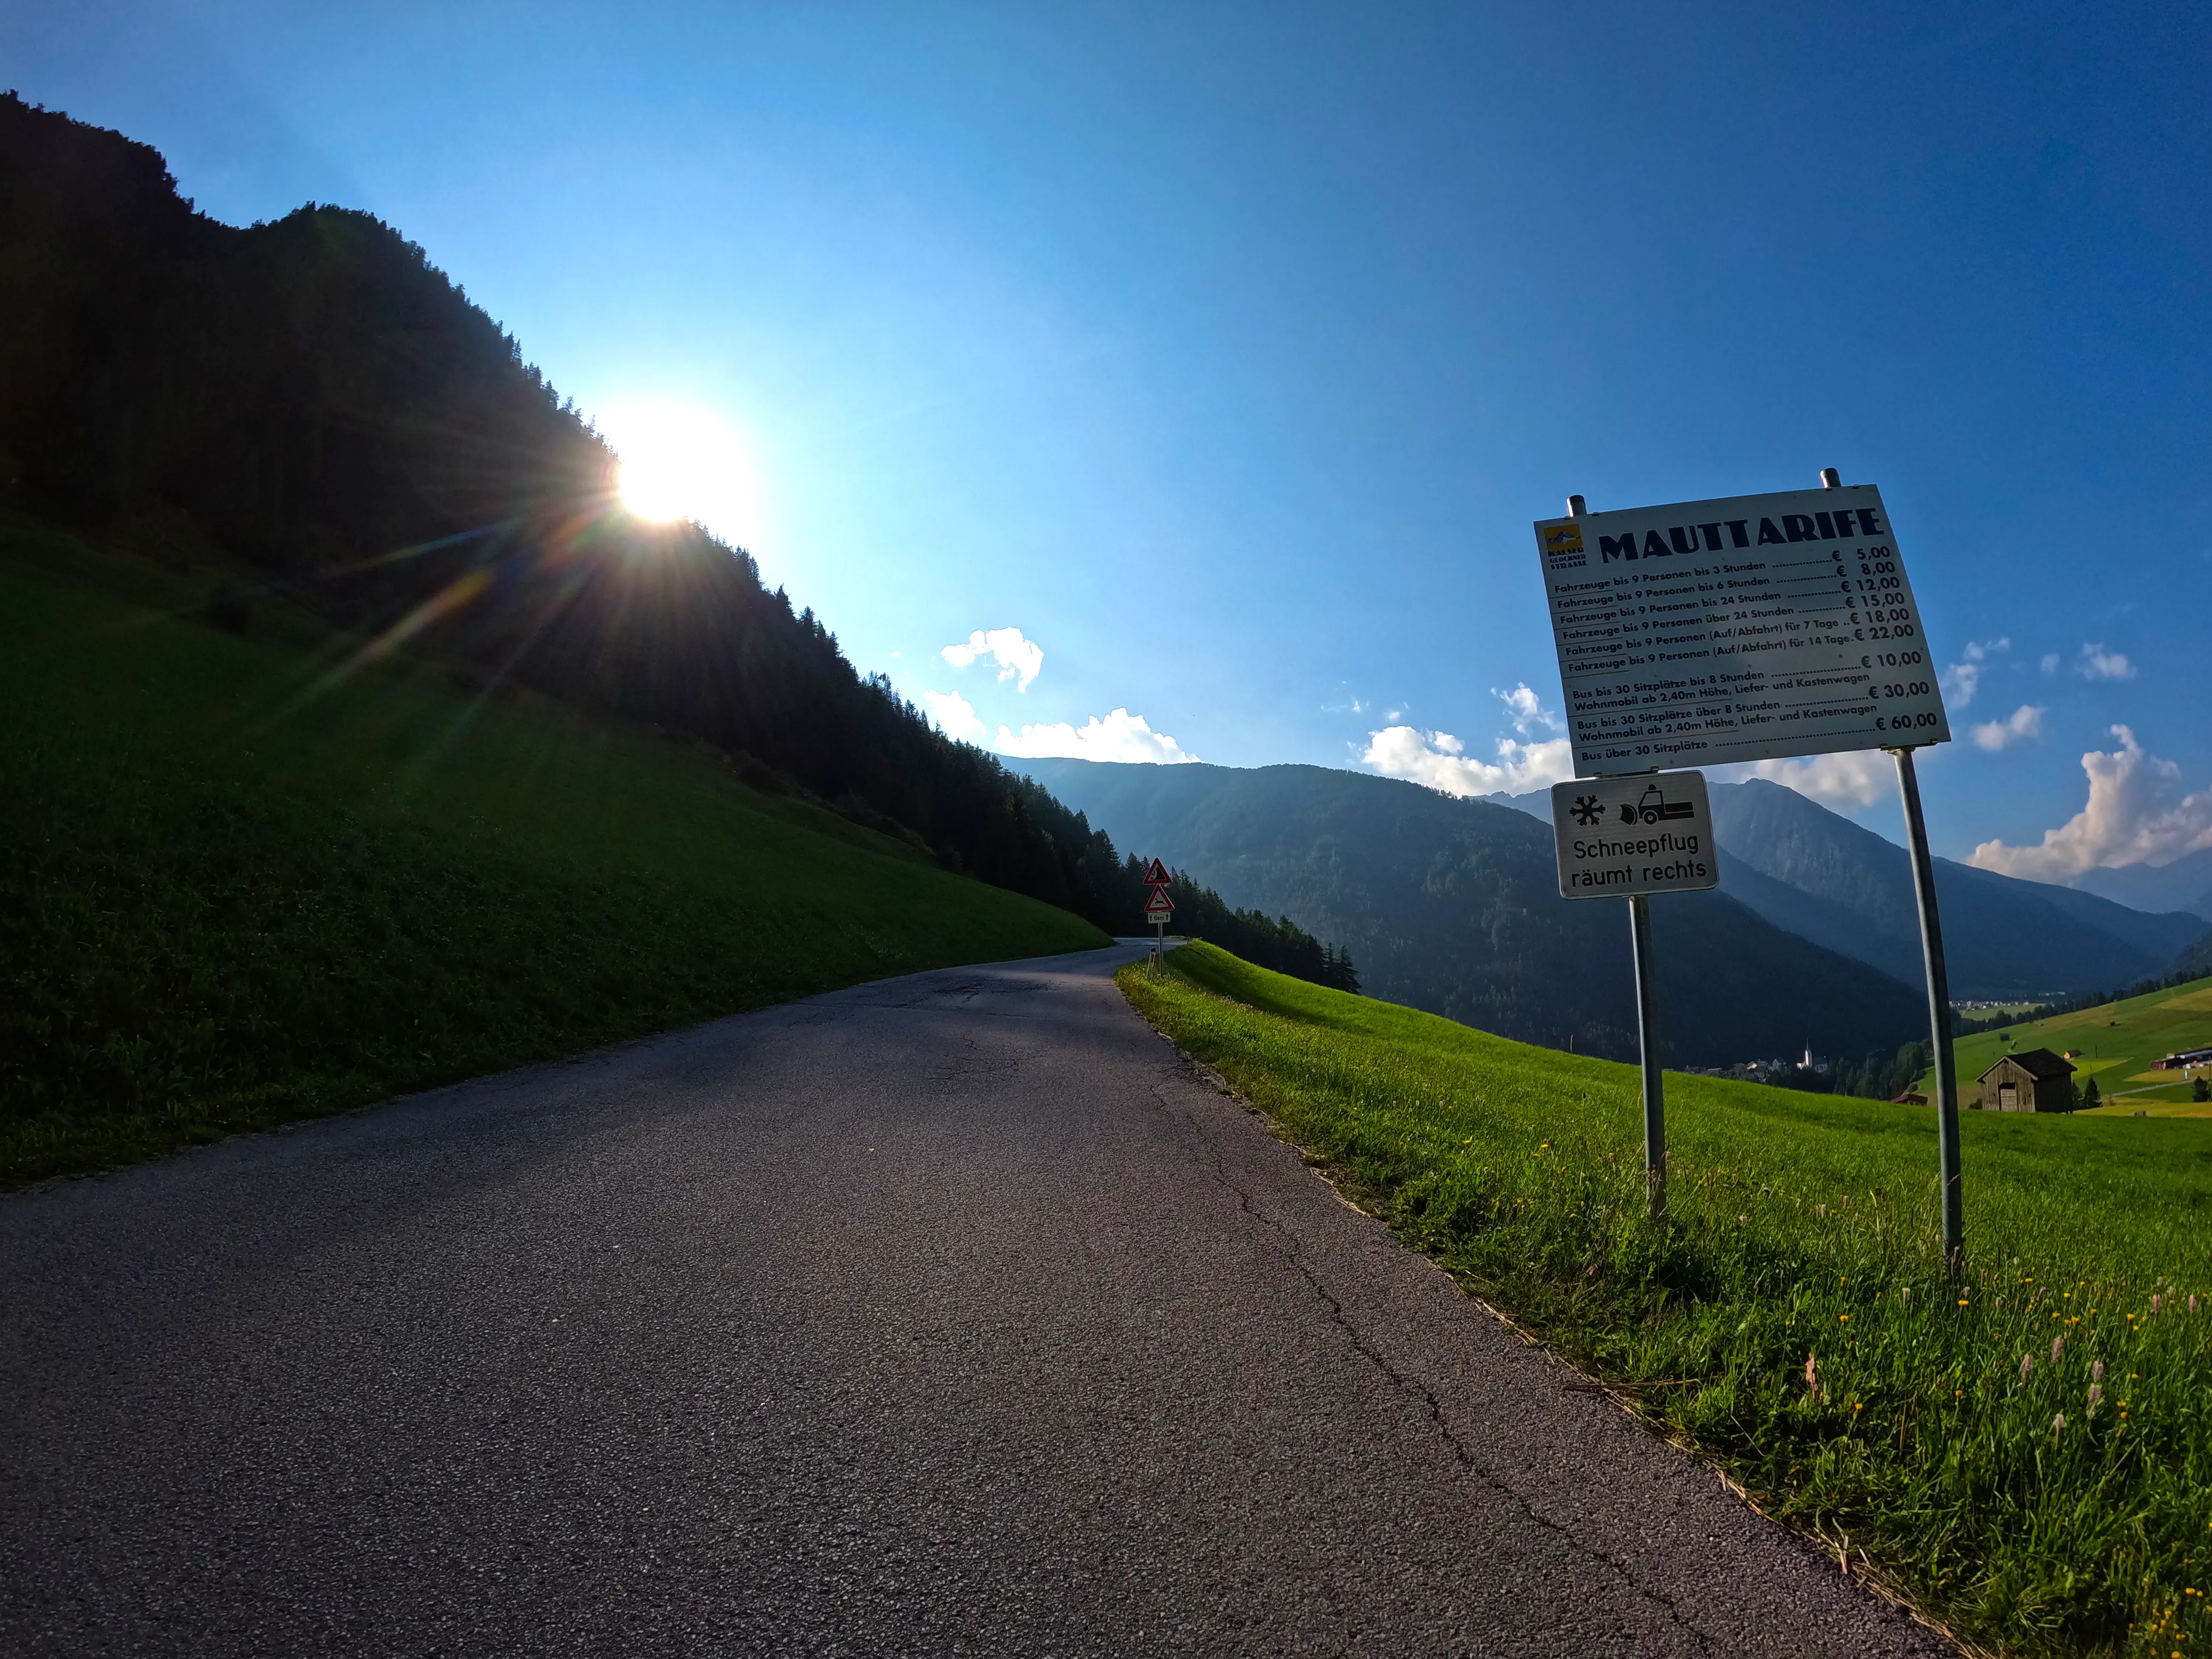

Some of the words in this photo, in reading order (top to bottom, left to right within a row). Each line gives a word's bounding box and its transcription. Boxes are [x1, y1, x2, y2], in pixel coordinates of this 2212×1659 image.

[1547, 546, 1584, 557] KALSER
[1549, 554, 1586, 563] GLOCKNER
[1598, 507, 1885, 564] MAUTTARIFE
[1550, 559, 1587, 570] STRASSE
[1554, 581, 1610, 593] Fahrzeuge
[1613, 576, 1629, 586] bis
[1631, 575, 1639, 583] 9
[1642, 571, 1692, 582] Personen
[1694, 567, 1710, 576] bis
[1712, 565, 1720, 574] 3
[1723, 562, 1766, 573] Stunden
[1831, 550, 1843, 562] €
[1857, 545, 1890, 560] 5,00
[1557, 596, 1614, 609] Fahrzeuge
[1616, 591, 1633, 601] bis
[1635, 590, 1642, 598] 9
[1645, 586, 1695, 597] Personen
[1697, 582, 1714, 591] bis
[1717, 581, 1724, 589] 6
[1727, 577, 1770, 588] Stunden
[1836, 565, 1847, 577] €
[1860, 561, 1896, 575] 8,00
[1560, 611, 1617, 624] Fahrzeuge
[1619, 607, 1636, 617] bis
[1638, 605, 1645, 615] 9
[1649, 602, 1699, 613] Personen
[1701, 598, 1717, 607] bis
[1720, 596, 1735, 605] 24
[1737, 591, 1781, 603] Stunden
[1840, 580, 1851, 593] €
[1856, 576, 1900, 591] 12,00
[1562, 627, 1620, 640] Fahrzeuge
[1622, 623, 1639, 632] bis
[1641, 621, 1649, 630] 9
[1652, 618, 1702, 629] Personen
[1705, 613, 1730, 623] über
[1733, 611, 1748, 620] 24
[1751, 606, 1794, 618] Stunden
[1844, 596, 1856, 609] €
[1860, 591, 1905, 607] 15,00
[1566, 643, 1623, 656] Fahrzeuge
[1625, 639, 1642, 649] bis
[1644, 637, 1652, 646] 9
[1655, 633, 1706, 645] Personen
[1709, 623, 1782, 641] (Auf/Abfahrt)
[1785, 622, 1800, 631] für
[1803, 621, 1810, 629] 7
[1812, 619, 1839, 630] Tage
[1849, 612, 1860, 625] €
[1865, 608, 1910, 623] 18,00
[1568, 659, 1626, 672] Fahrzeuge
[1628, 655, 1645, 665] bis
[1648, 653, 1656, 663] 9
[1658, 650, 1710, 662] Personen
[1712, 639, 1786, 658] (Auf/Abfahrt)
[1789, 638, 1805, 648] für
[1808, 636, 1822, 645] 14
[1853, 628, 1865, 641] €
[1869, 624, 1914, 640] 22,00
[1572, 690, 1593, 699] Bus
[1595, 686, 1612, 697] bis
[1615, 684, 1630, 694] 30
[1633, 679, 1687, 692] Sitzplätze
[1689, 676, 1706, 686] bis
[1709, 675, 1717, 684] 8
[1719, 670, 1764, 683] Stunden
[1860, 655, 1872, 669] €
[1877, 651, 1921, 666] 10,00
[1574, 695, 1638, 711] Wohnmobil
[1641, 694, 1657, 704] ab
[1660, 690, 1696, 702] 2,40m
[1698, 686, 1732, 698] Höhe,
[1734, 682, 1769, 693] Liefer-
[1772, 678, 1793, 690] und
[1796, 674, 1870, 687] Kastenwagen
[1577, 720, 1597, 730] Bus
[1600, 717, 1617, 727] bis
[1620, 714, 1635, 725] 30
[1638, 710, 1692, 723] Sitzplätze
[1695, 706, 1721, 717] über
[1724, 704, 1732, 714] 8
[1735, 700, 1781, 712] Stunden
[1868, 685, 1879, 699] €
[1884, 681, 1930, 698] 30,00
[1578, 726, 1643, 742] Wohnmobil
[1647, 725, 1662, 734] ab
[1665, 721, 1702, 733] 2,40m
[1704, 717, 1738, 729] Höhe,
[1741, 713, 1775, 725] Liefer-
[1779, 710, 1800, 721] und
[1802, 705, 1877, 719] Kastenwagen
[1581, 752, 1602, 761] Bus
[1605, 747, 1631, 758] über
[1635, 745, 1650, 756] 30
[1653, 740, 1708, 753] Sitzplätze
[1875, 717, 1886, 731] €
[1891, 712, 1937, 730] 60,00
[1574, 833, 1699, 859] Schneepflug
[1572, 865, 1633, 887] räumt
[1643, 860, 1707, 881] rechts
